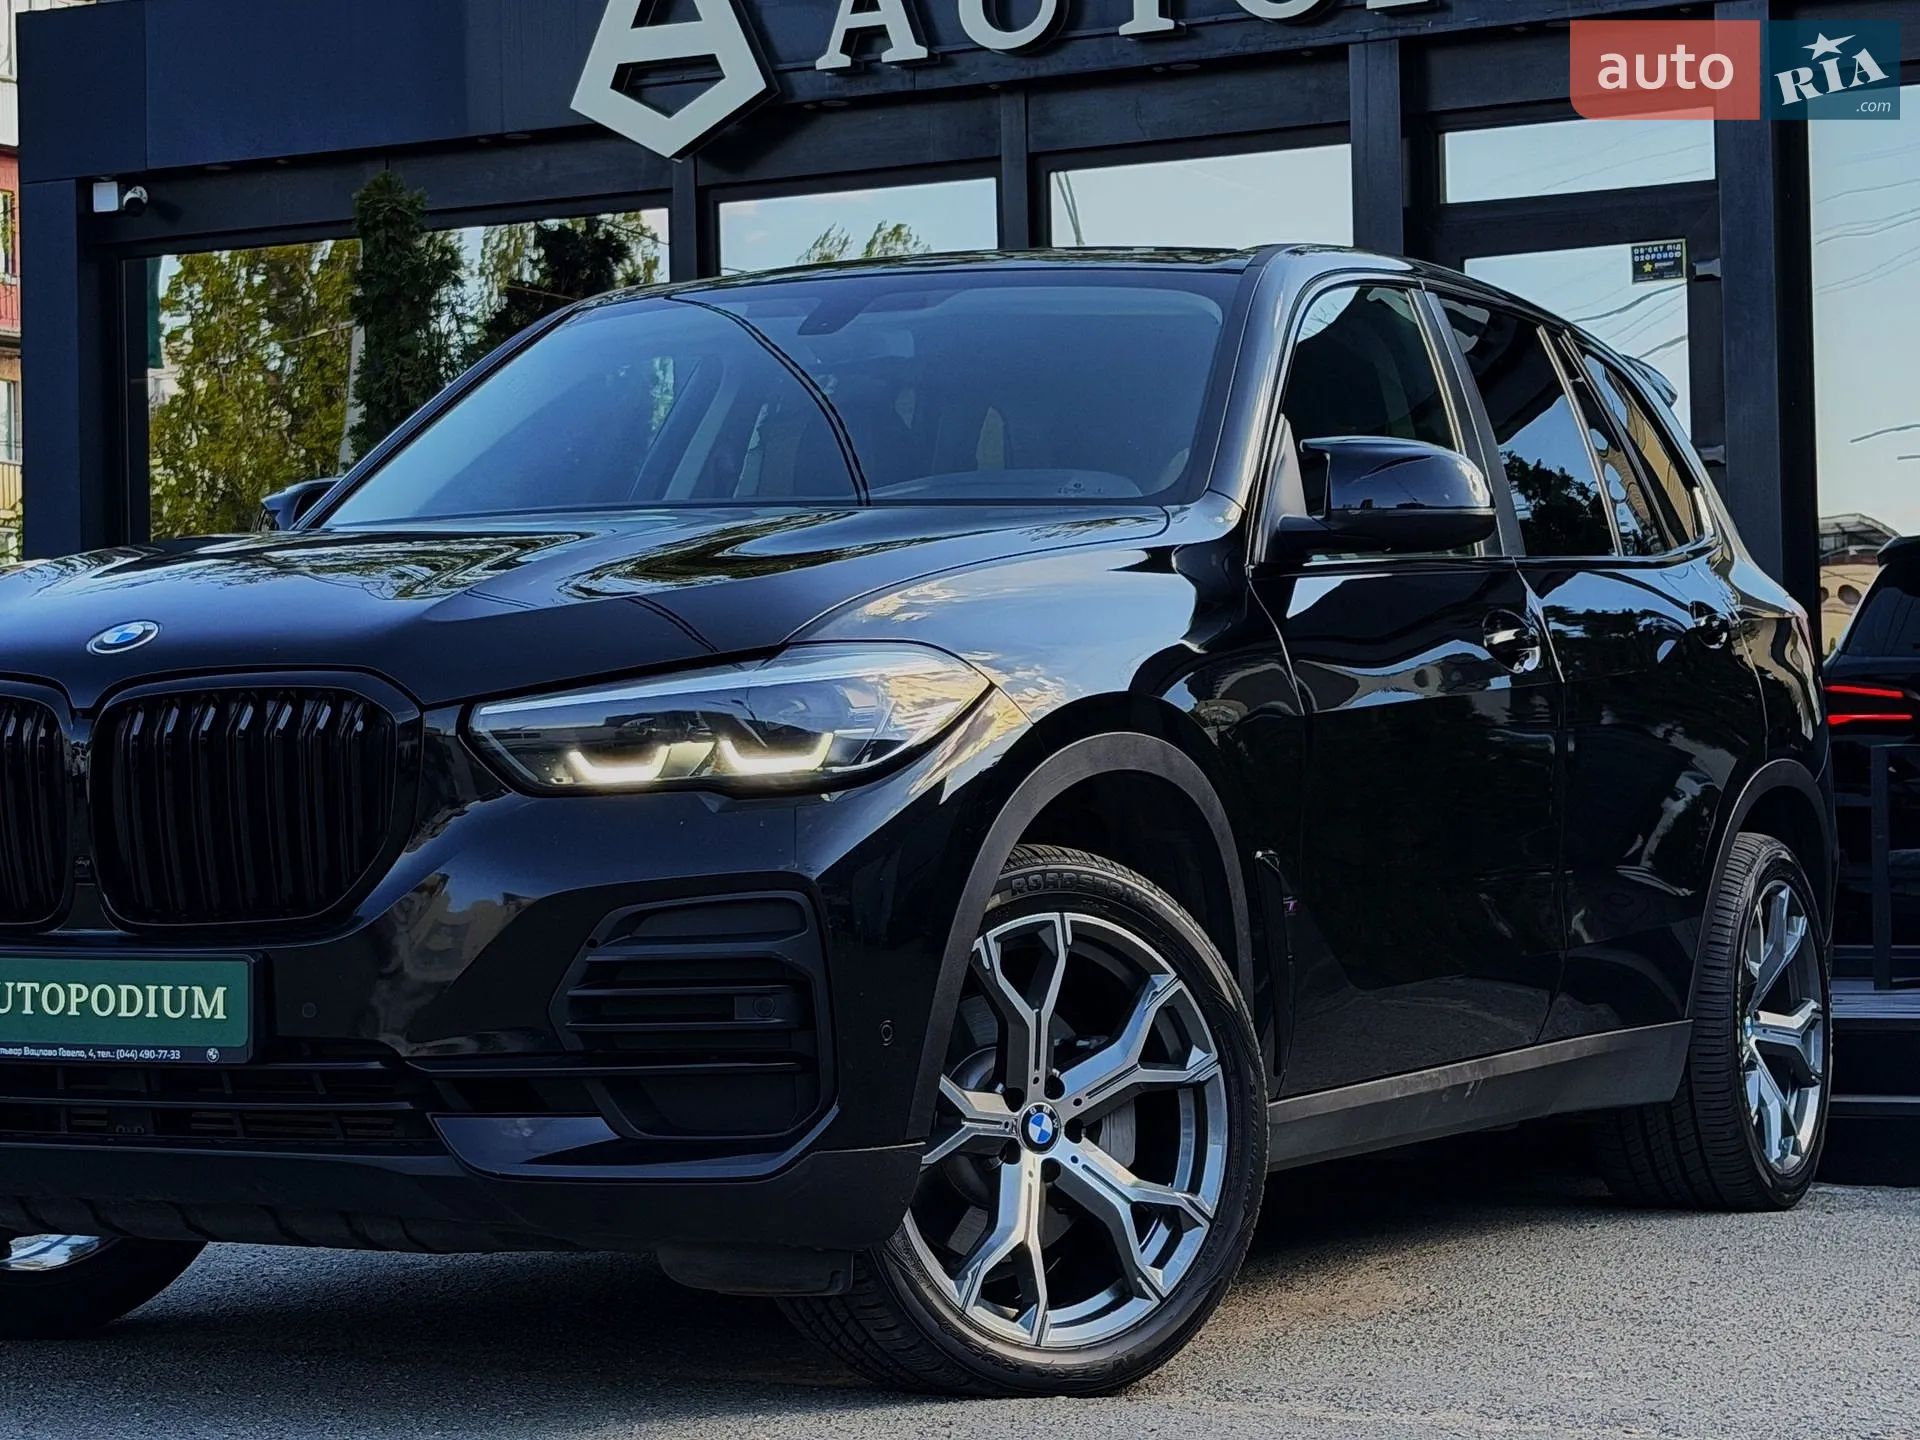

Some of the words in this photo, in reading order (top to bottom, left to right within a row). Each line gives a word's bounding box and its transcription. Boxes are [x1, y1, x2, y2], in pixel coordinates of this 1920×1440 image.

[88, 1048, 96, 1059] 4,
[116, 1049, 138, 1060] (044)
[139, 1049, 181, 1060] 490-77-33
